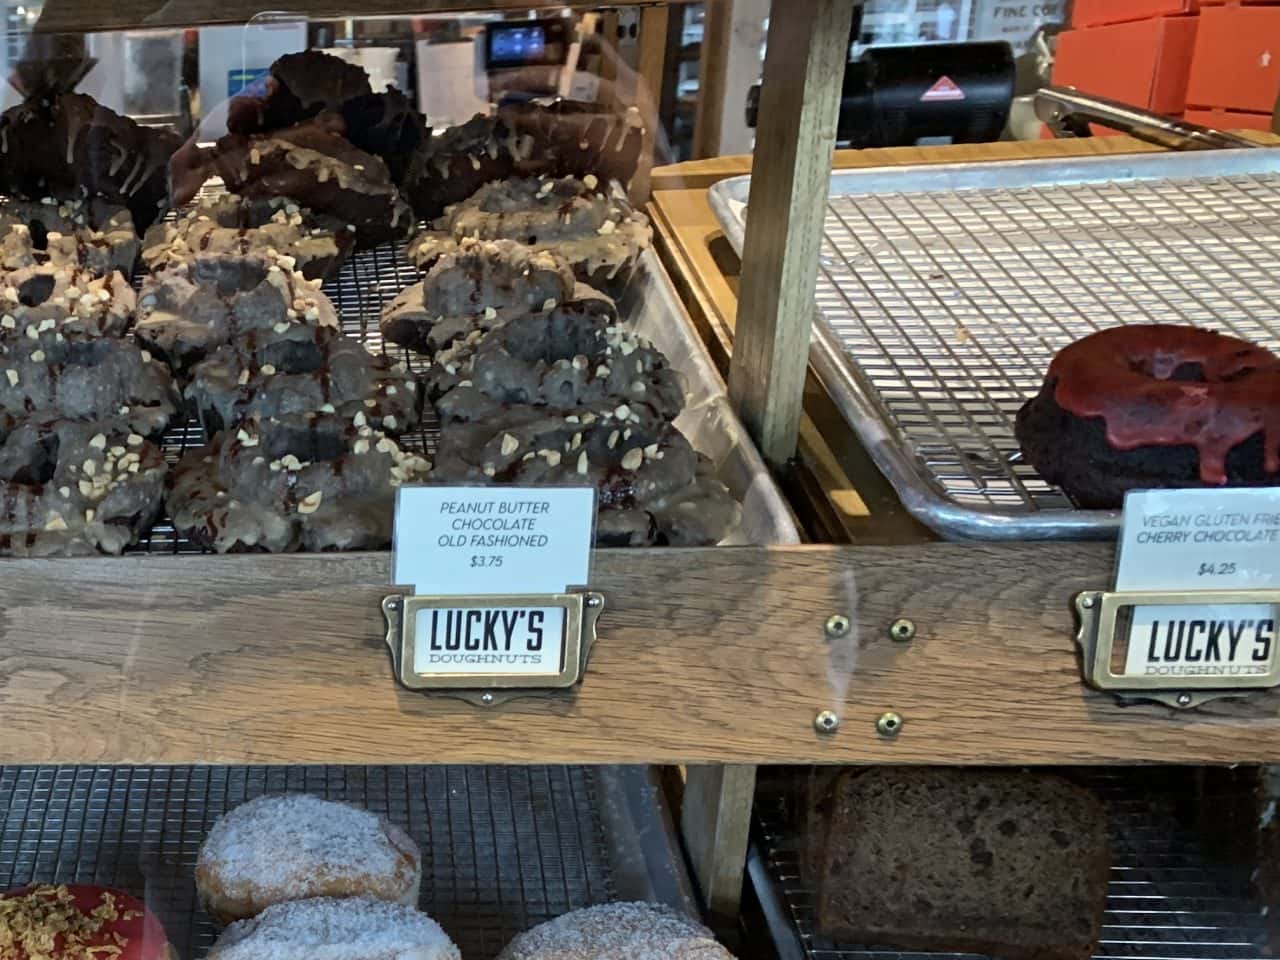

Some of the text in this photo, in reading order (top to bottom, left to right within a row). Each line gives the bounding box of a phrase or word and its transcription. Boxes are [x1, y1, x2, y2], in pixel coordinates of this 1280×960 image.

[440, 502, 550, 514] PEANUT BUTTER
[452, 518, 536, 530] CHOCOLATE
[1143, 515, 1191, 528] VEGAN
[1194, 513, 1250, 526] GLUTEN
[438, 534, 548, 547] OLD FASHIONED
[1137, 529, 1278, 543] CHERRY CHOCOLATE
[470, 555, 503, 567] $3.75
[1197, 562, 1237, 576] $4.25
[430, 610, 544, 651] LUCKY'S
[1147, 619, 1274, 662] LUCKY'S
[429, 654, 542, 664] DOUGHNUTS
[1144, 665, 1267, 676] DOUGHNUTS
